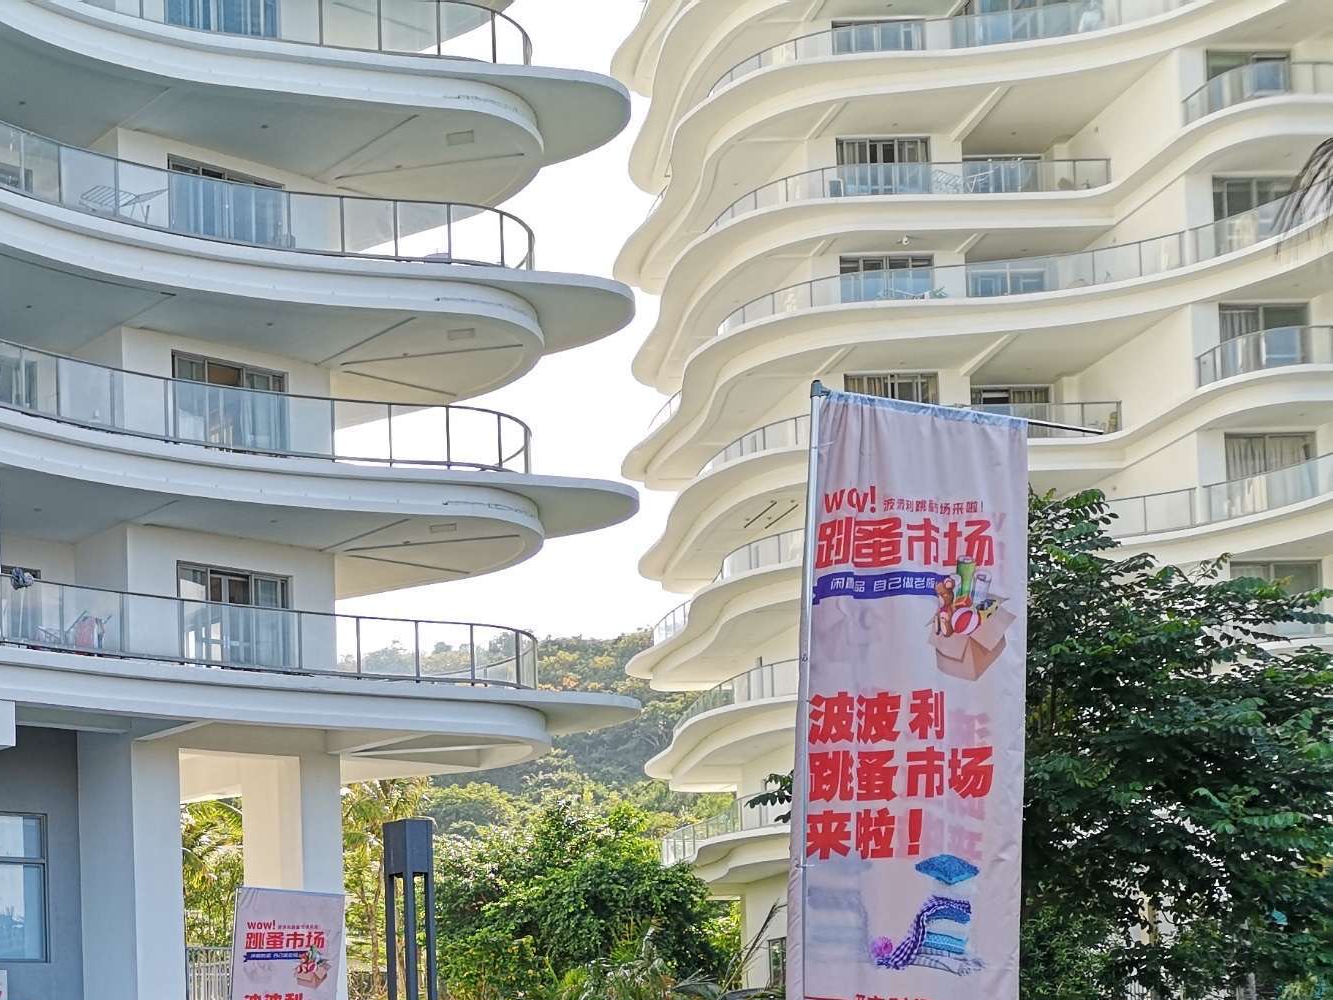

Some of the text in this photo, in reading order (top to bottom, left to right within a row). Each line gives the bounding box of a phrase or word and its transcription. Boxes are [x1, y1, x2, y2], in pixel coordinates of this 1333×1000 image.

[815, 517, 995, 569] 跳蚤市场
[873, 576, 936, 593] 自己做老板
[808, 688, 945, 745] 波波利
[808, 746, 994, 803] 跳蚤市场
[806, 807, 923, 860] 来啦！
[245, 931, 326, 950] 跳蚤市场
